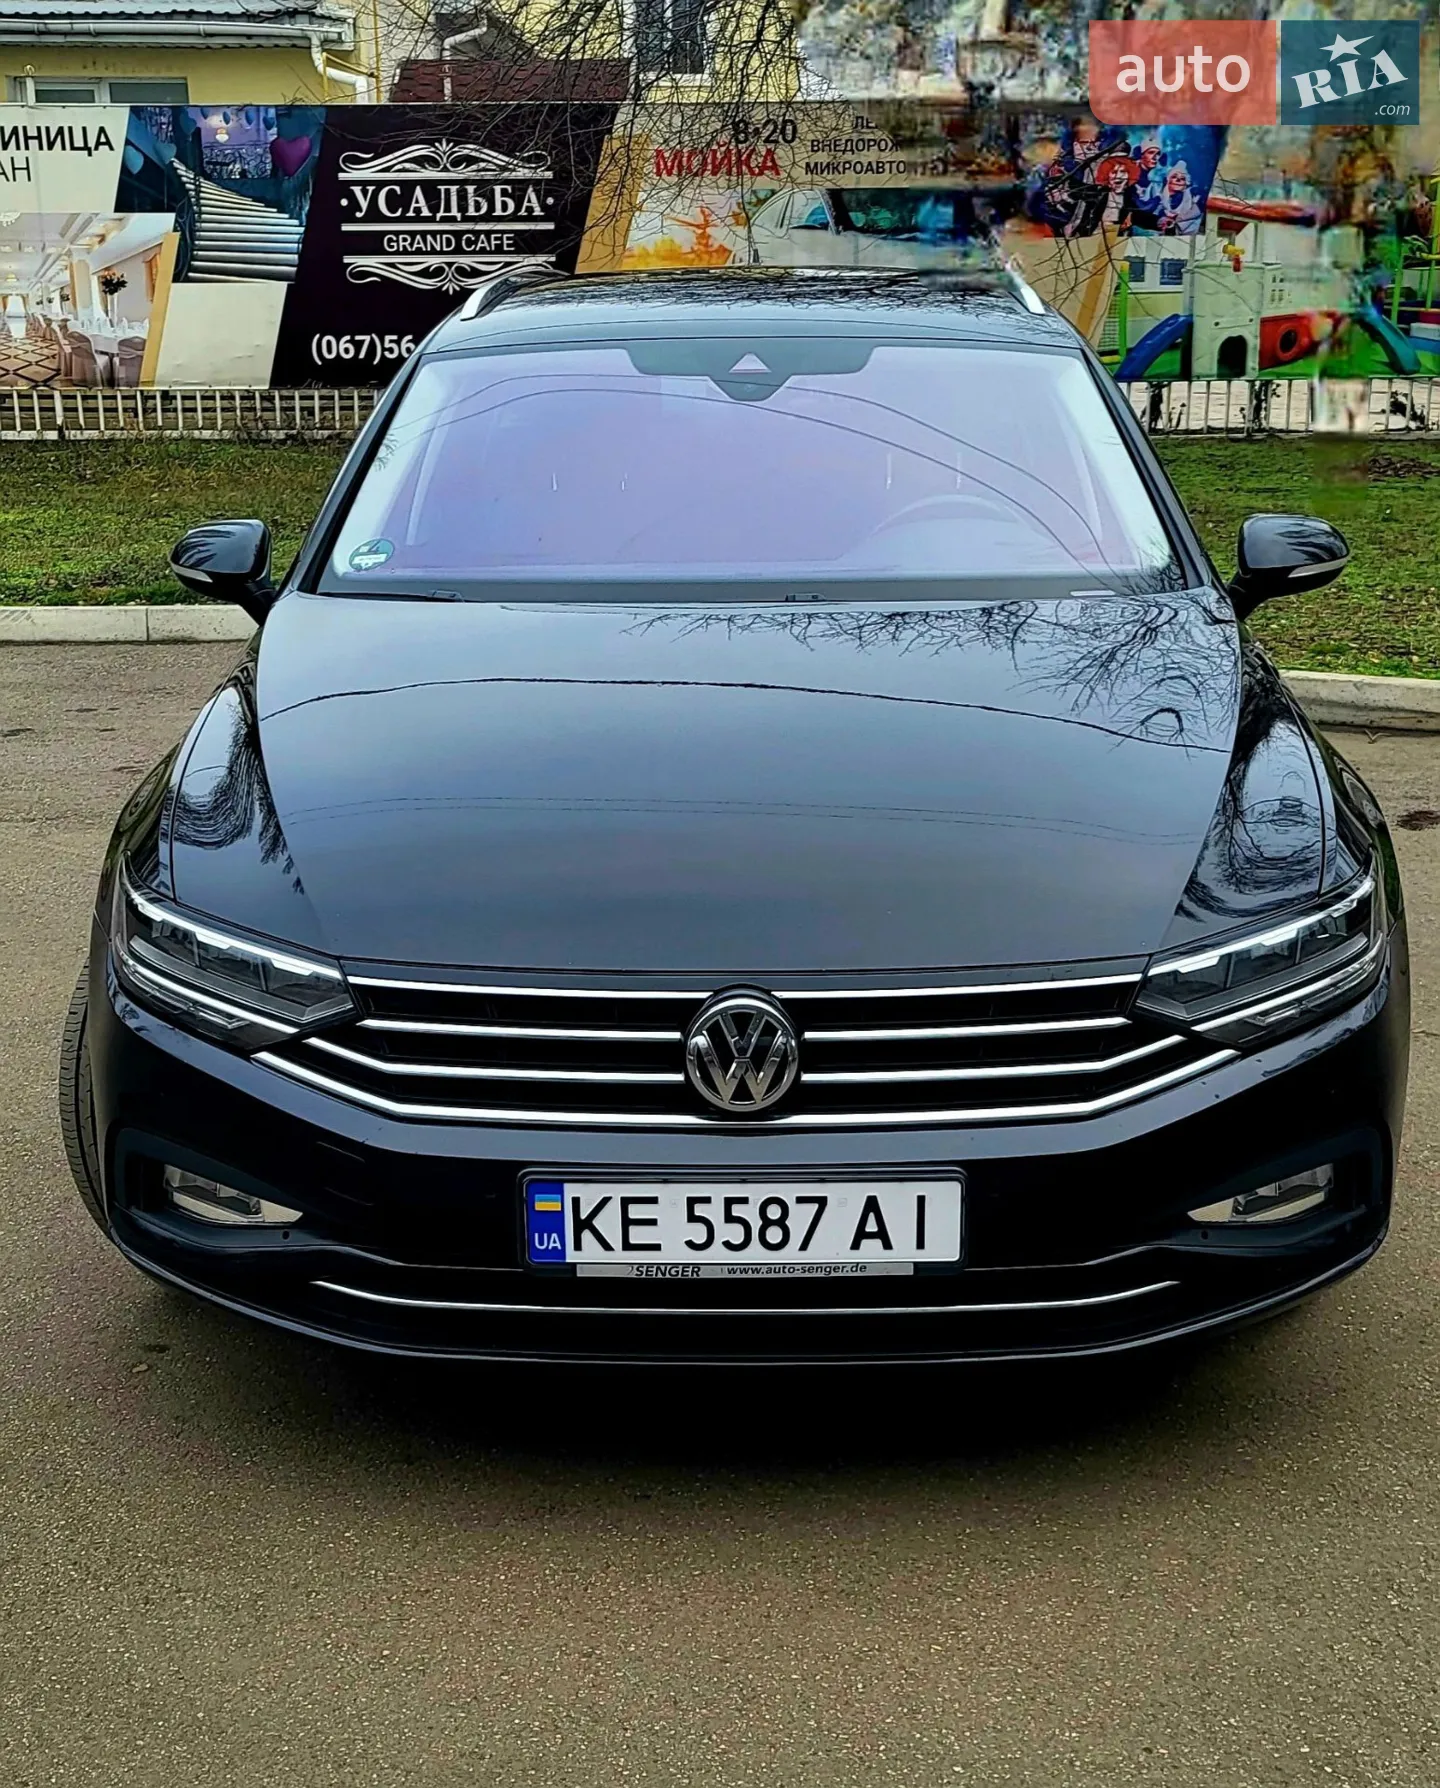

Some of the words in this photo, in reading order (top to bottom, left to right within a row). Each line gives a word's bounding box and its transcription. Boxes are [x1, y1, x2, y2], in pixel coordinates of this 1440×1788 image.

[0, 125, 115, 157] ИНИЦА
[654, 140, 781, 177] МОЙКА
[383, 234, 455, 251] GRAND
[461, 233, 516, 250] CAFE
[571, 1196, 663, 1251] KE
[684, 1196, 829, 1251] 5587
[534, 1232, 562, 1250] UA
[634, 1265, 701, 1277] SENGER
[726, 1263, 867, 1276] www.auto-senger.de
